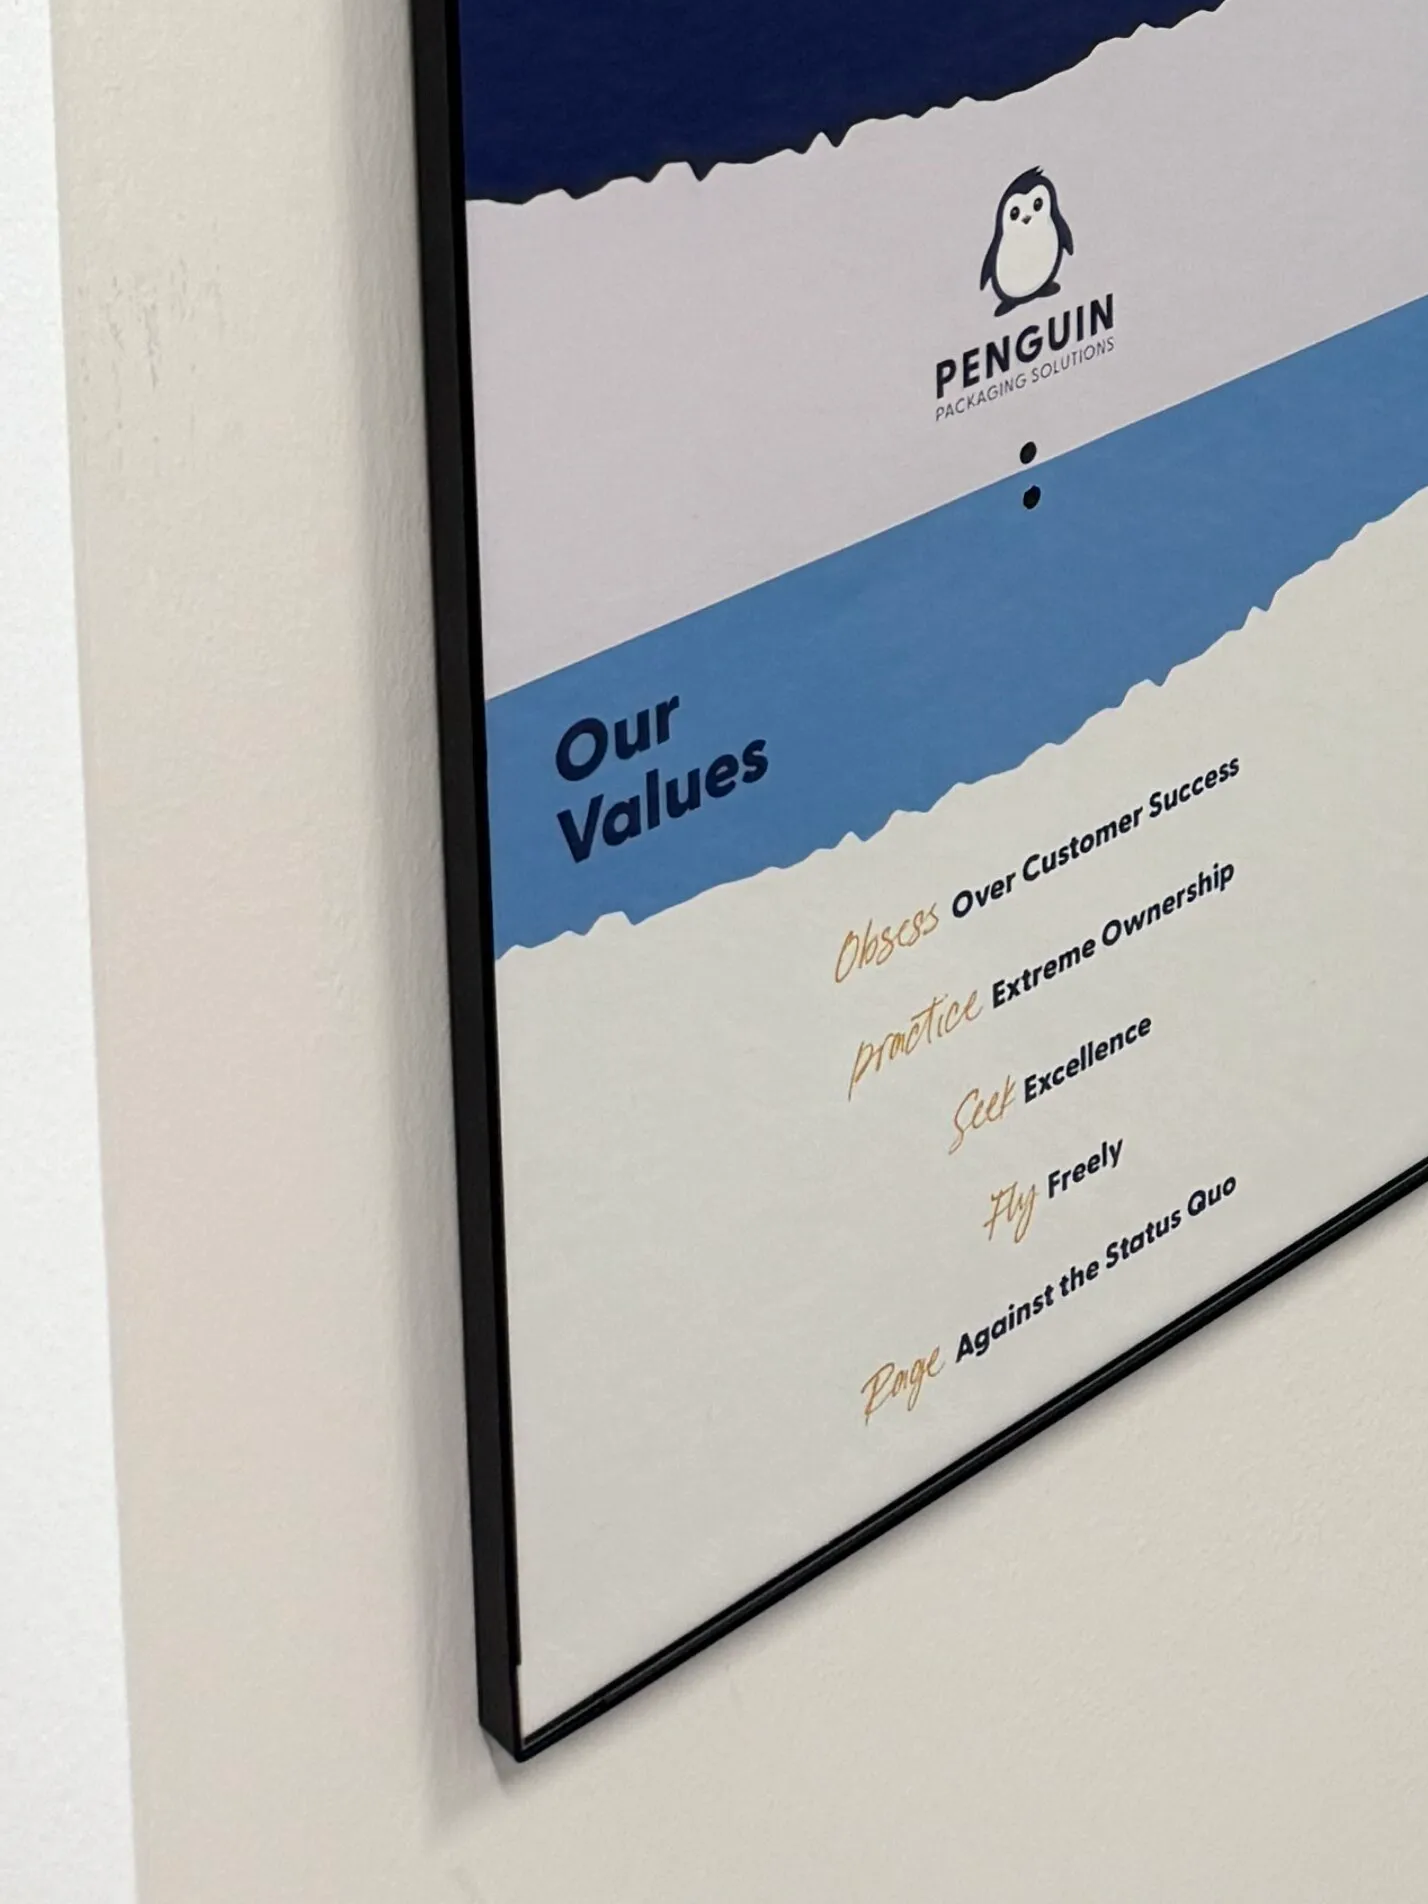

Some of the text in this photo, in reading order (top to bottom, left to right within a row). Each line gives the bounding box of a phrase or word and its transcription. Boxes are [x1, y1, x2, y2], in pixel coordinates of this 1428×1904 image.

[935, 292, 1115, 400] PENGUIN
[935, 336, 1116, 422] PACKAGING SOLUTIONS
[555, 694, 681, 782] Our
[556, 738, 769, 864] Values
[835, 759, 1239, 984] Obsess Over Customer Success
[993, 940, 1096, 1007] Extreme
[1102, 864, 1234, 945] Ownership
[948, 1019, 1151, 1155] Seek Excellence
[983, 1140, 1122, 1245] Fly Freely
[956, 1286, 1054, 1361] Against
[1060, 1262, 1099, 1296] the
[1106, 1211, 1181, 1268] Status
[1188, 1177, 1236, 1216] Quo
